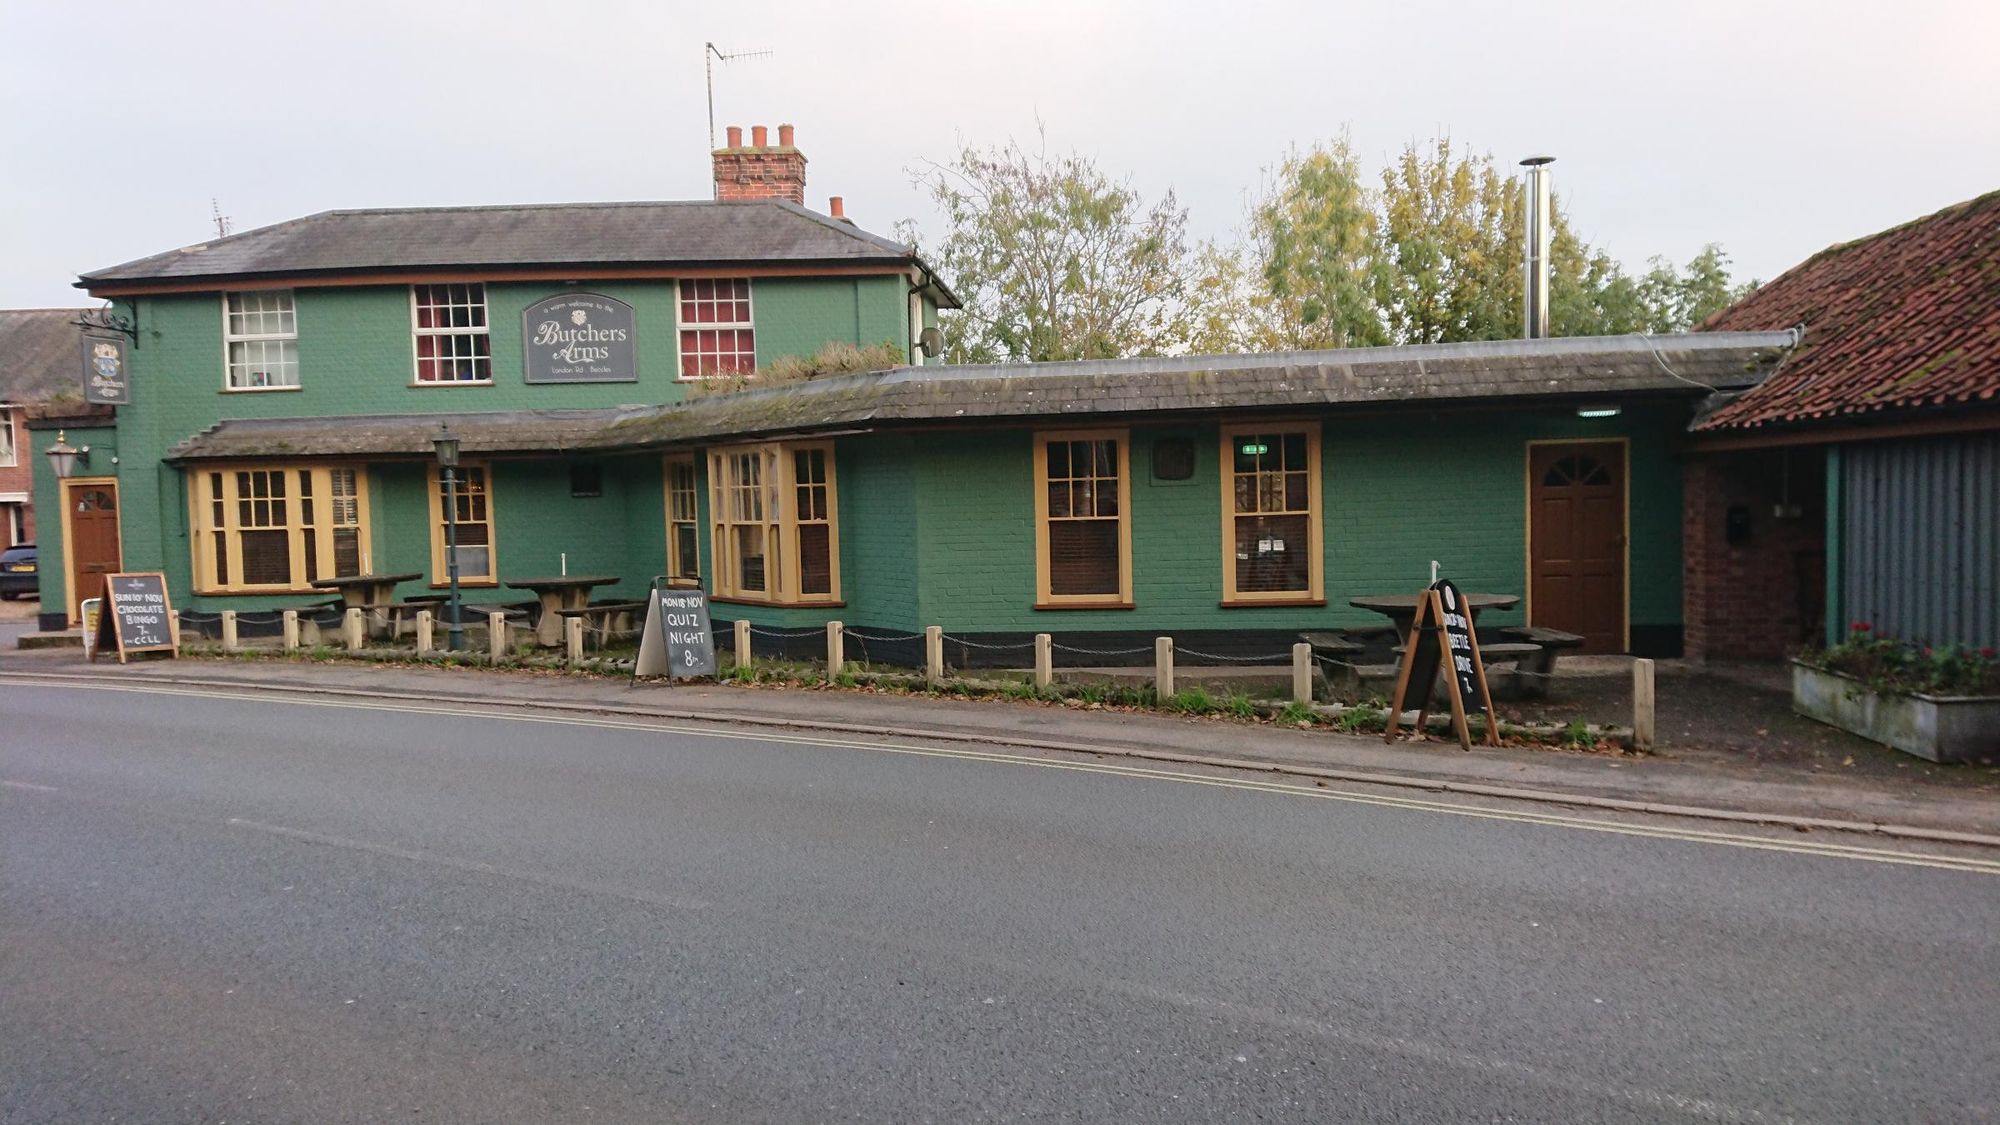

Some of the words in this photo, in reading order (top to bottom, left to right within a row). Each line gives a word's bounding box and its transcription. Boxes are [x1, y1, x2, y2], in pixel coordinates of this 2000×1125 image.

[605, 305, 615, 313] the
[533, 320, 627, 345] Butchers
[552, 340, 609, 364] Arms
[115, 594, 131, 602] SUN
[145, 594, 163, 603] NOV
[662, 598, 678, 607] MON
[687, 597, 703, 608] NOV
[117, 605, 165, 615] CHOCOLATE
[125, 614, 158, 625] BINGO
[667, 613, 699, 627] QUIZ
[134, 635, 161, 645] CCLL
[669, 631, 705, 644] NIGHT
[1455, 655, 1474, 674] DRIVE
